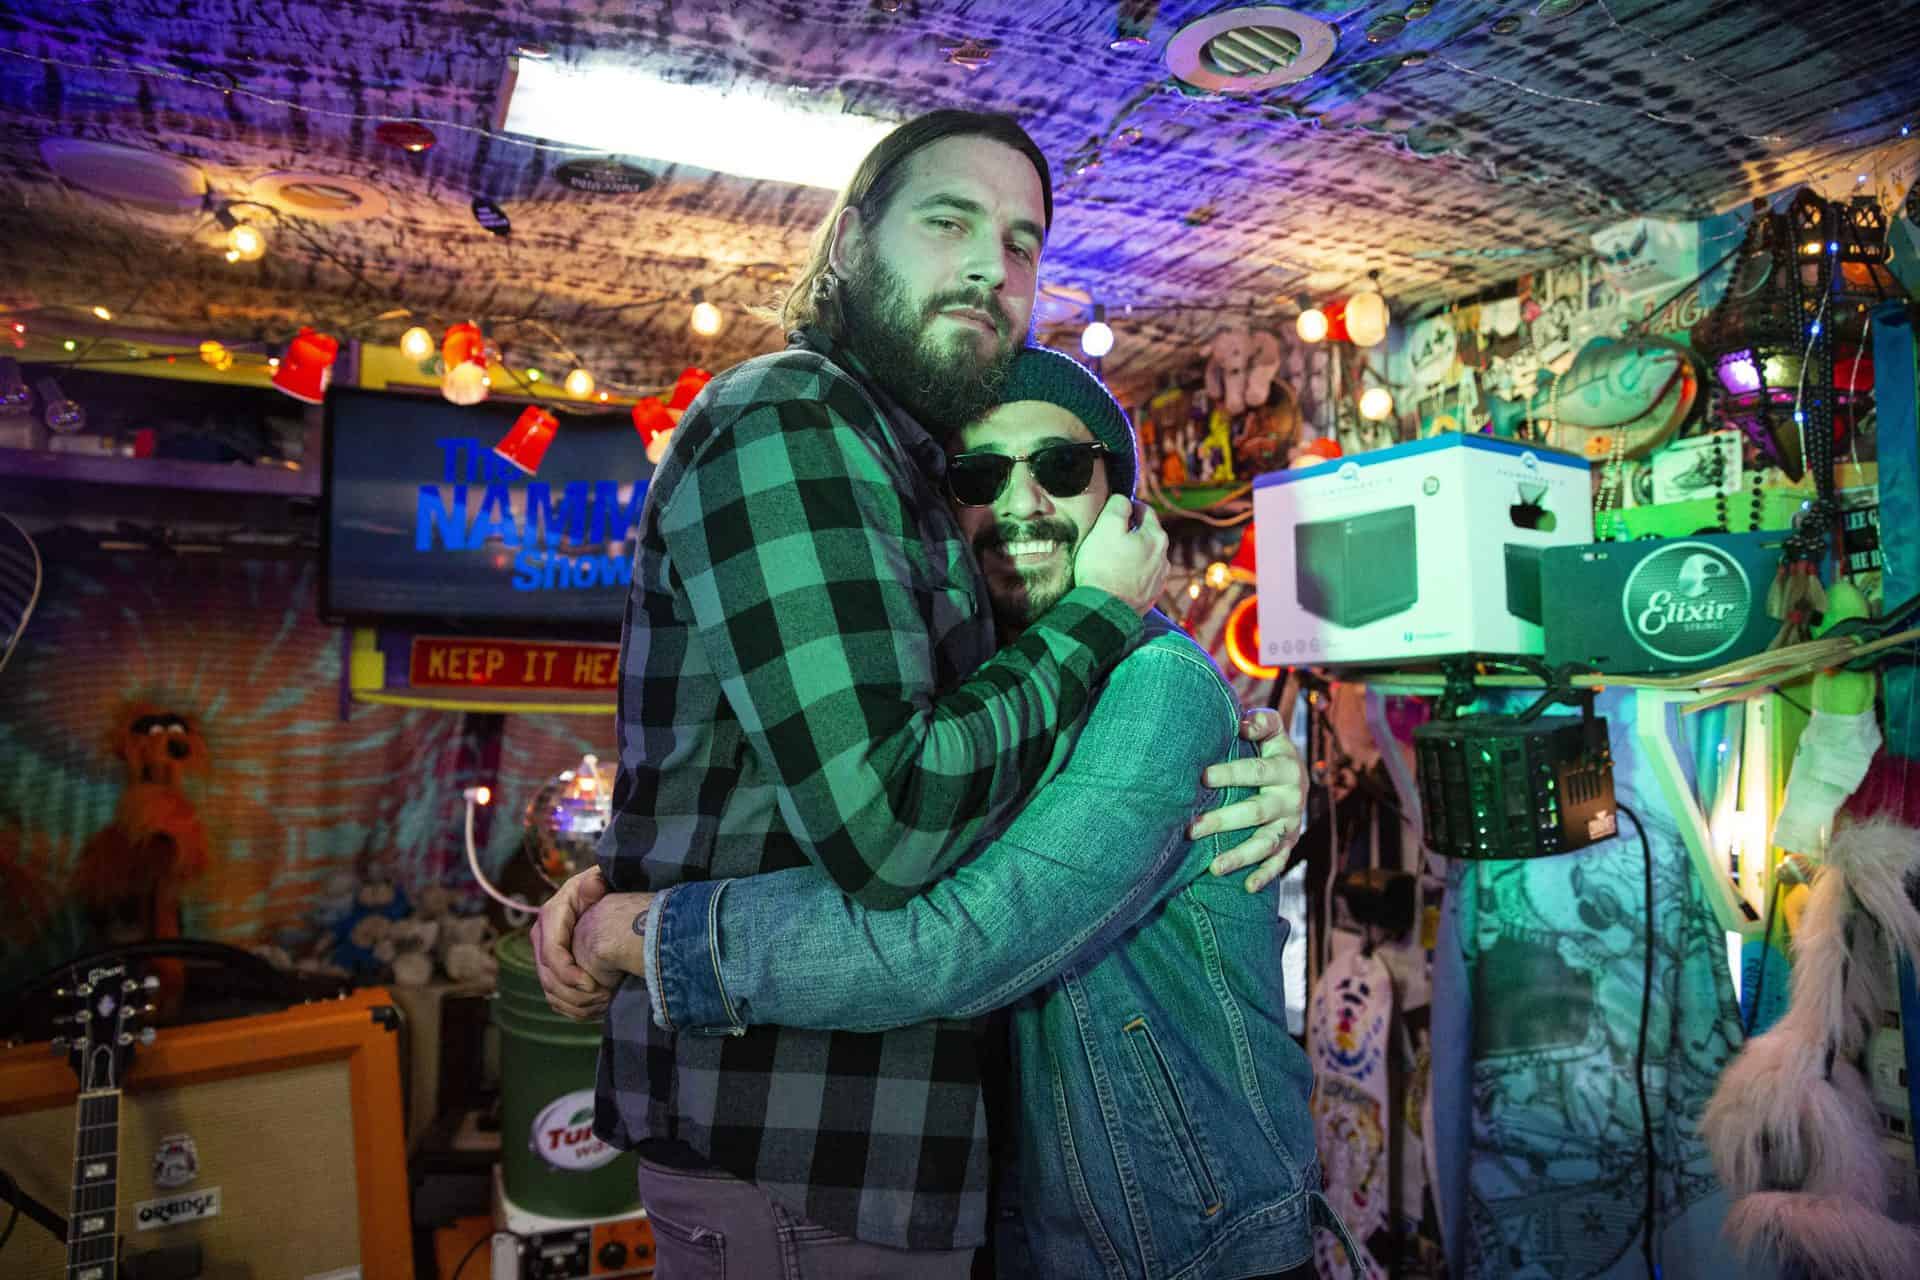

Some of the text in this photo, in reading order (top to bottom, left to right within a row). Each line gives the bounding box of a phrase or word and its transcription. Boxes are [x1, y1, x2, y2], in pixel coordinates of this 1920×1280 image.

[415, 480, 648, 550] NAMM
[512, 549, 632, 591] Show
[1638, 590, 1735, 635] Elixir
[428, 648, 504, 680] KEEP
[523, 651, 558, 682] IT
